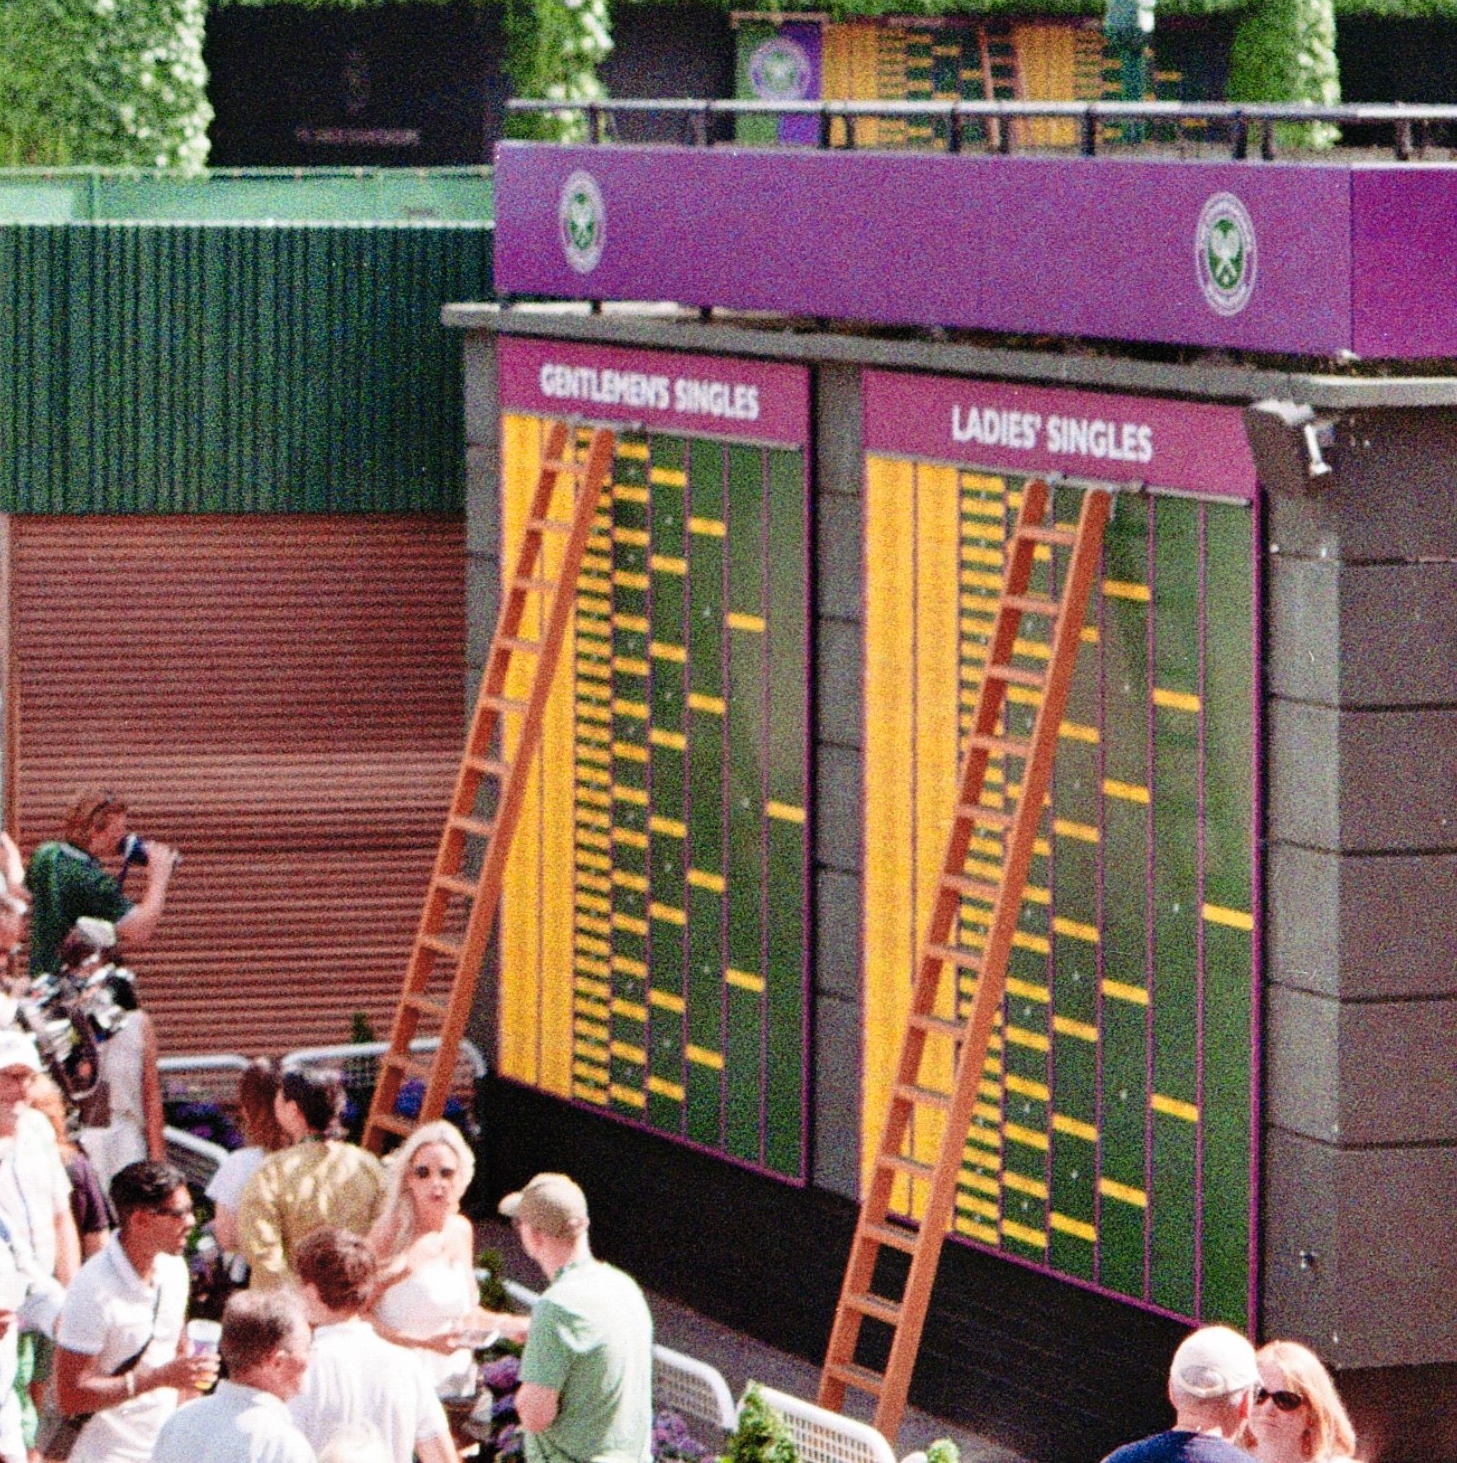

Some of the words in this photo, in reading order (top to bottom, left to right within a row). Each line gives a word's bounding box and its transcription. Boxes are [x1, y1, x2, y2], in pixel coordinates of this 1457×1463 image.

[674, 379, 759, 420] SINGLES
[952, 405, 1042, 450] LADIES'
[1046, 418, 1153, 463] SINGLES
